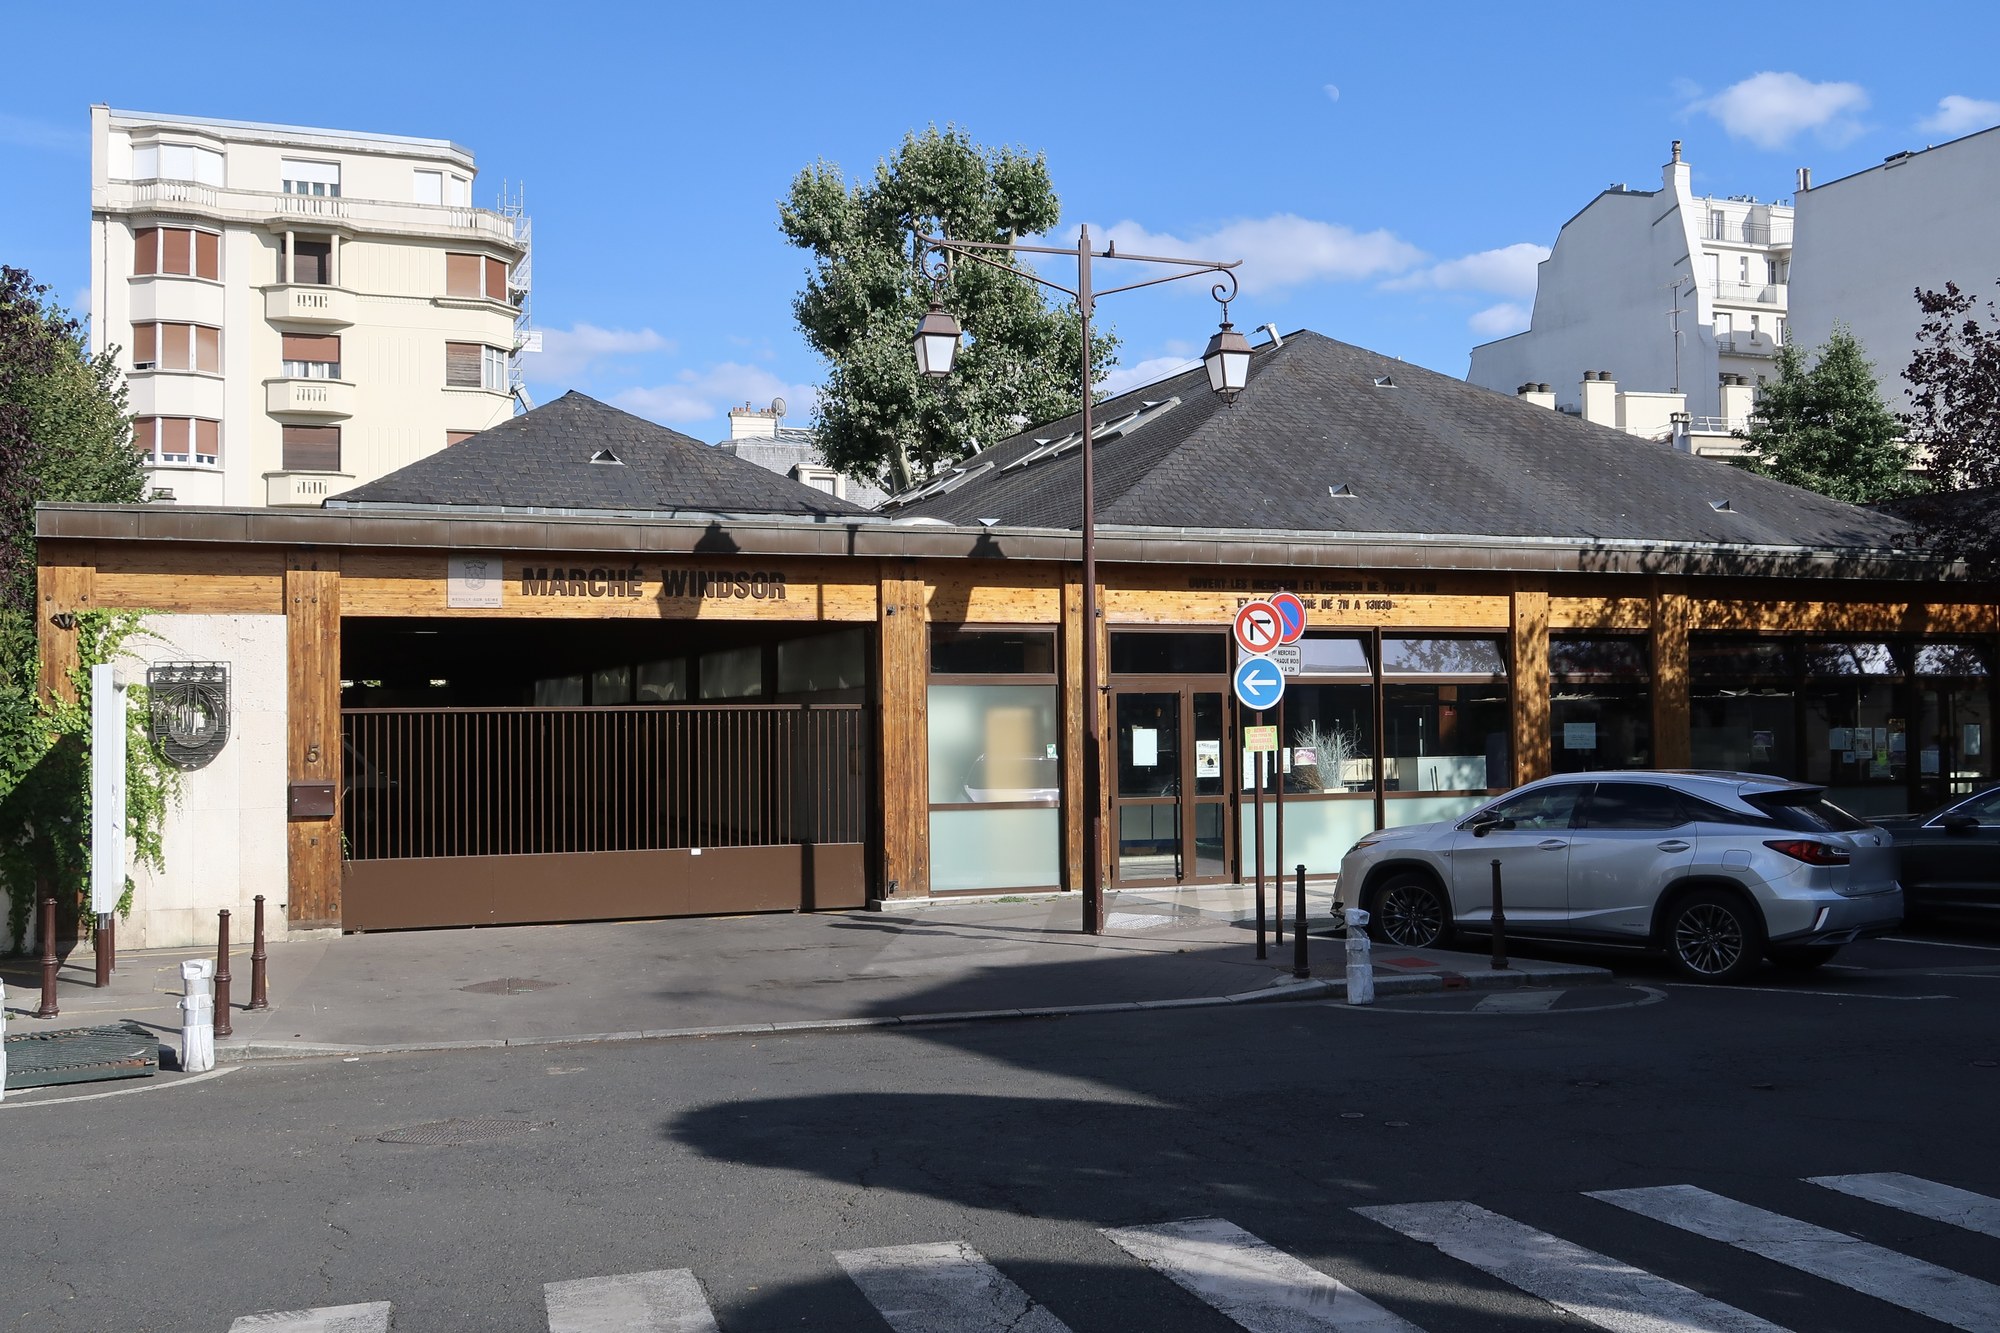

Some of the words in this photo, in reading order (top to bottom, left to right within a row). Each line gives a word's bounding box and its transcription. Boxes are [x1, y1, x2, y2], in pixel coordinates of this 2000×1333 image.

[522, 563, 643, 598] MARCHÉ
[661, 569, 787, 599] WINDSOR
[1188, 577, 1226, 588] OUVERT
[1231, 578, 1247, 589] LES
[1303, 580, 1314, 590] ET
[1320, 580, 1363, 591] VENDREDI
[1367, 581, 1379, 591] DE
[1321, 598, 1333, 609] DE
[1337, 599, 1349, 610] 7H
[1365, 600, 1393, 610] 13H30
[307, 744, 320, 763] 5
